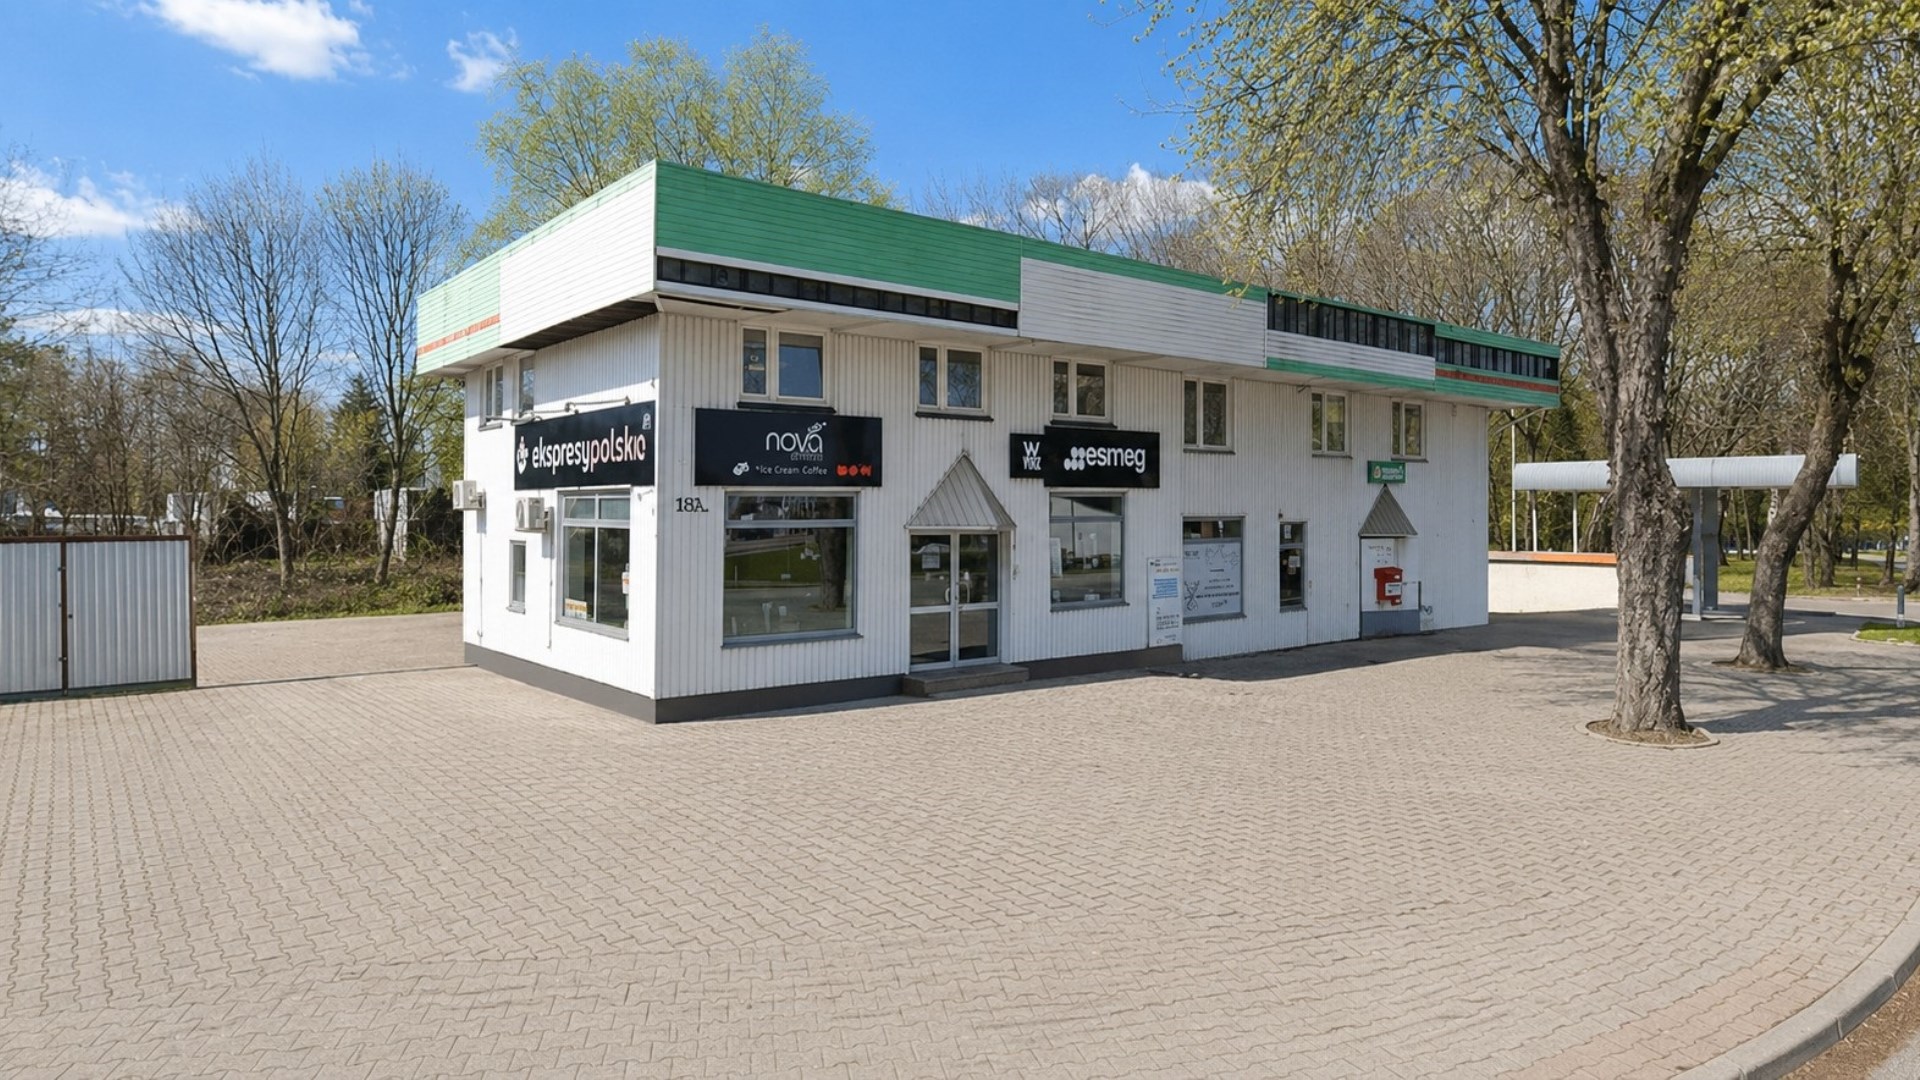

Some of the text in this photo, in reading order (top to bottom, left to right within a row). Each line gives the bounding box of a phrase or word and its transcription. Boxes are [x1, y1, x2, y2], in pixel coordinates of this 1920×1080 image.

[1086, 446, 1146, 473] esmeg
[774, 465, 800, 475] Cream
[802, 465, 828, 475] Coffee
